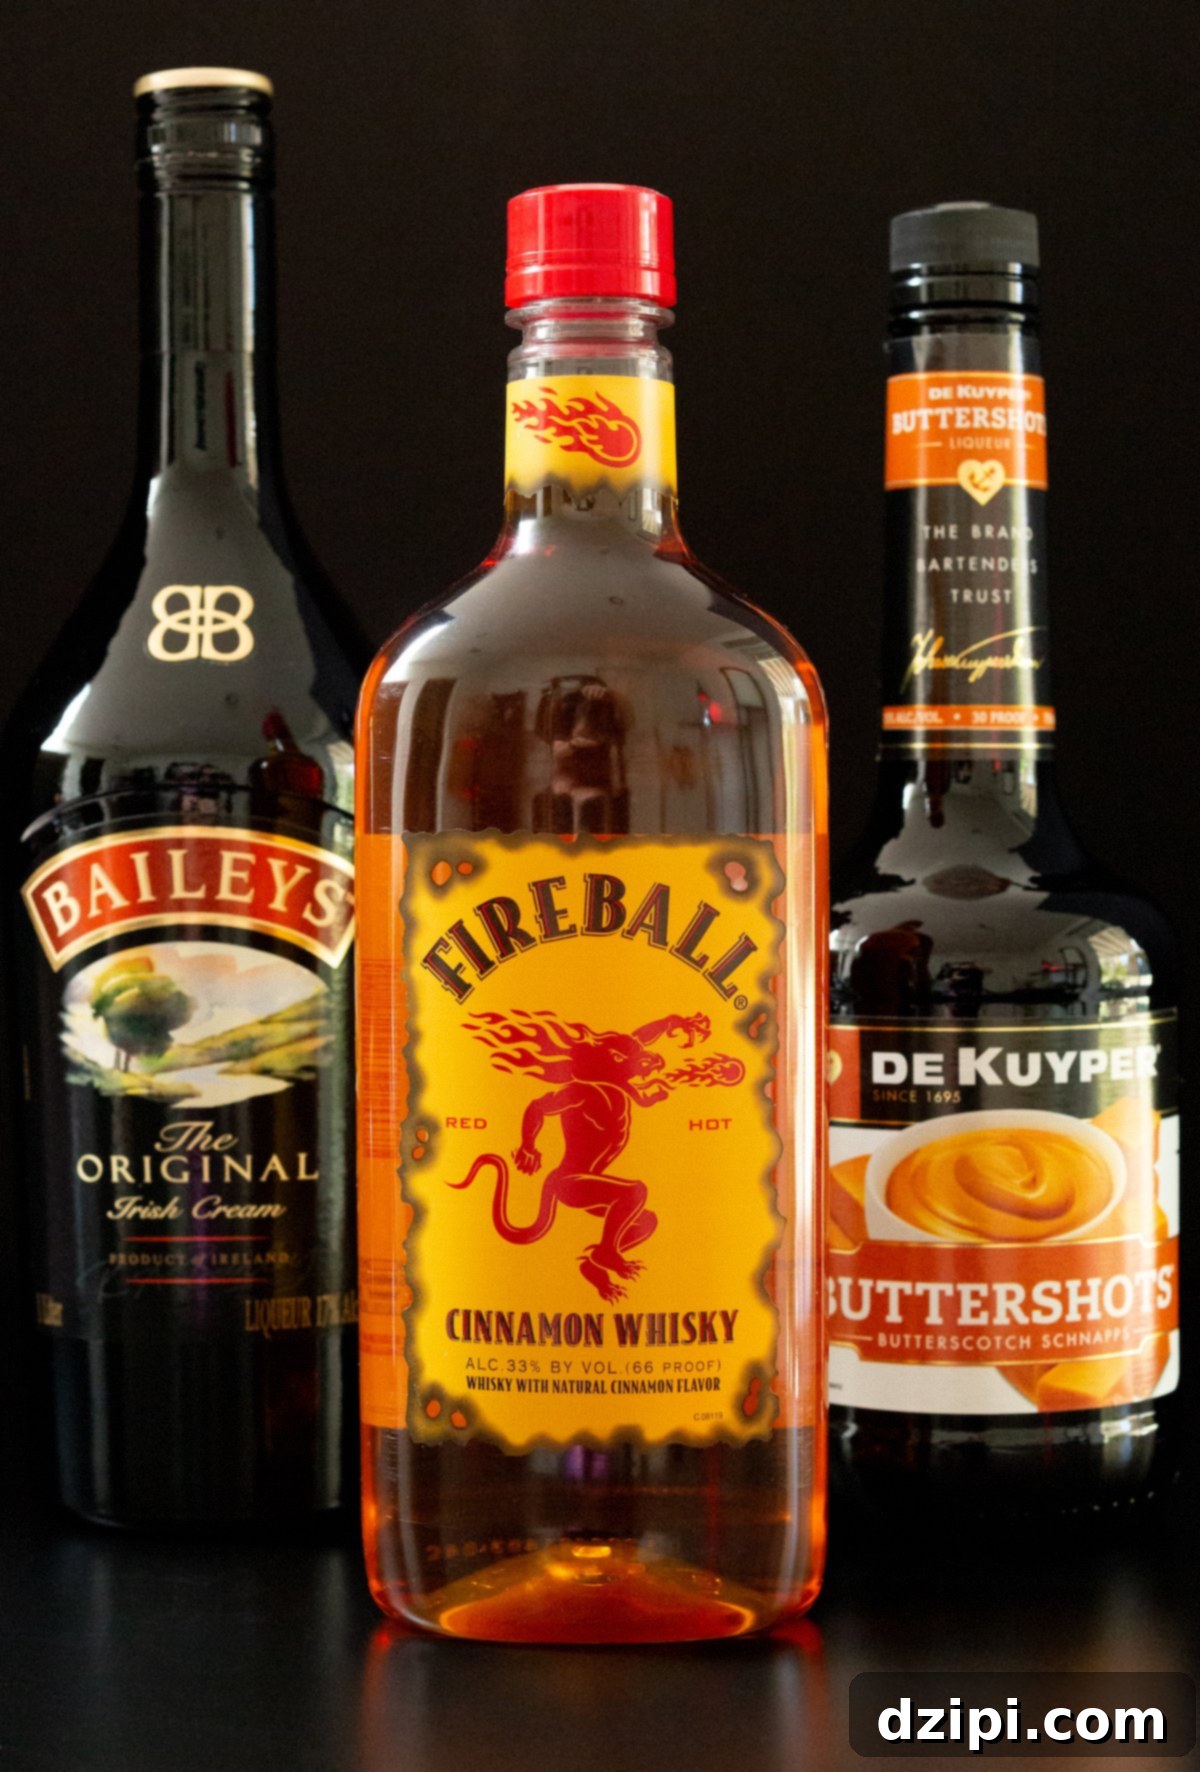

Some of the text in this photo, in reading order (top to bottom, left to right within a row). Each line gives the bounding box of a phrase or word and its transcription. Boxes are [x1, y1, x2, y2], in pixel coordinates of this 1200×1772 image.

[929, 386, 953, 400] DE
[949, 437, 1011, 449] LIQUEUR
[923, 525, 958, 539] THE
[951, 588, 1012, 604] TRUST
[42, 849, 346, 937] BAILEYS
[872, 1046, 1158, 1087] DE KUYPER
[873, 1089, 962, 1103] SINCE 1695
[445, 1117, 733, 1131] RED HOT
[154, 1121, 238, 1151] The
[76, 1153, 319, 1183] ORIGINAL
[106, 1195, 287, 1220] Irish Cream
[211, 1252, 290, 1266] IRELAND
[446, 1309, 739, 1347] CINNAMON WHISKY
[877, 1328, 1131, 1351] BUTTERSCOTCH SCHNAPPS
[550, 1360, 573, 1374] BY
[662, 1359, 722, 1374] PROOF)
[466, 1376, 721, 1395] WHISKY WITH NATURAL CINNAMON FLAVOR
